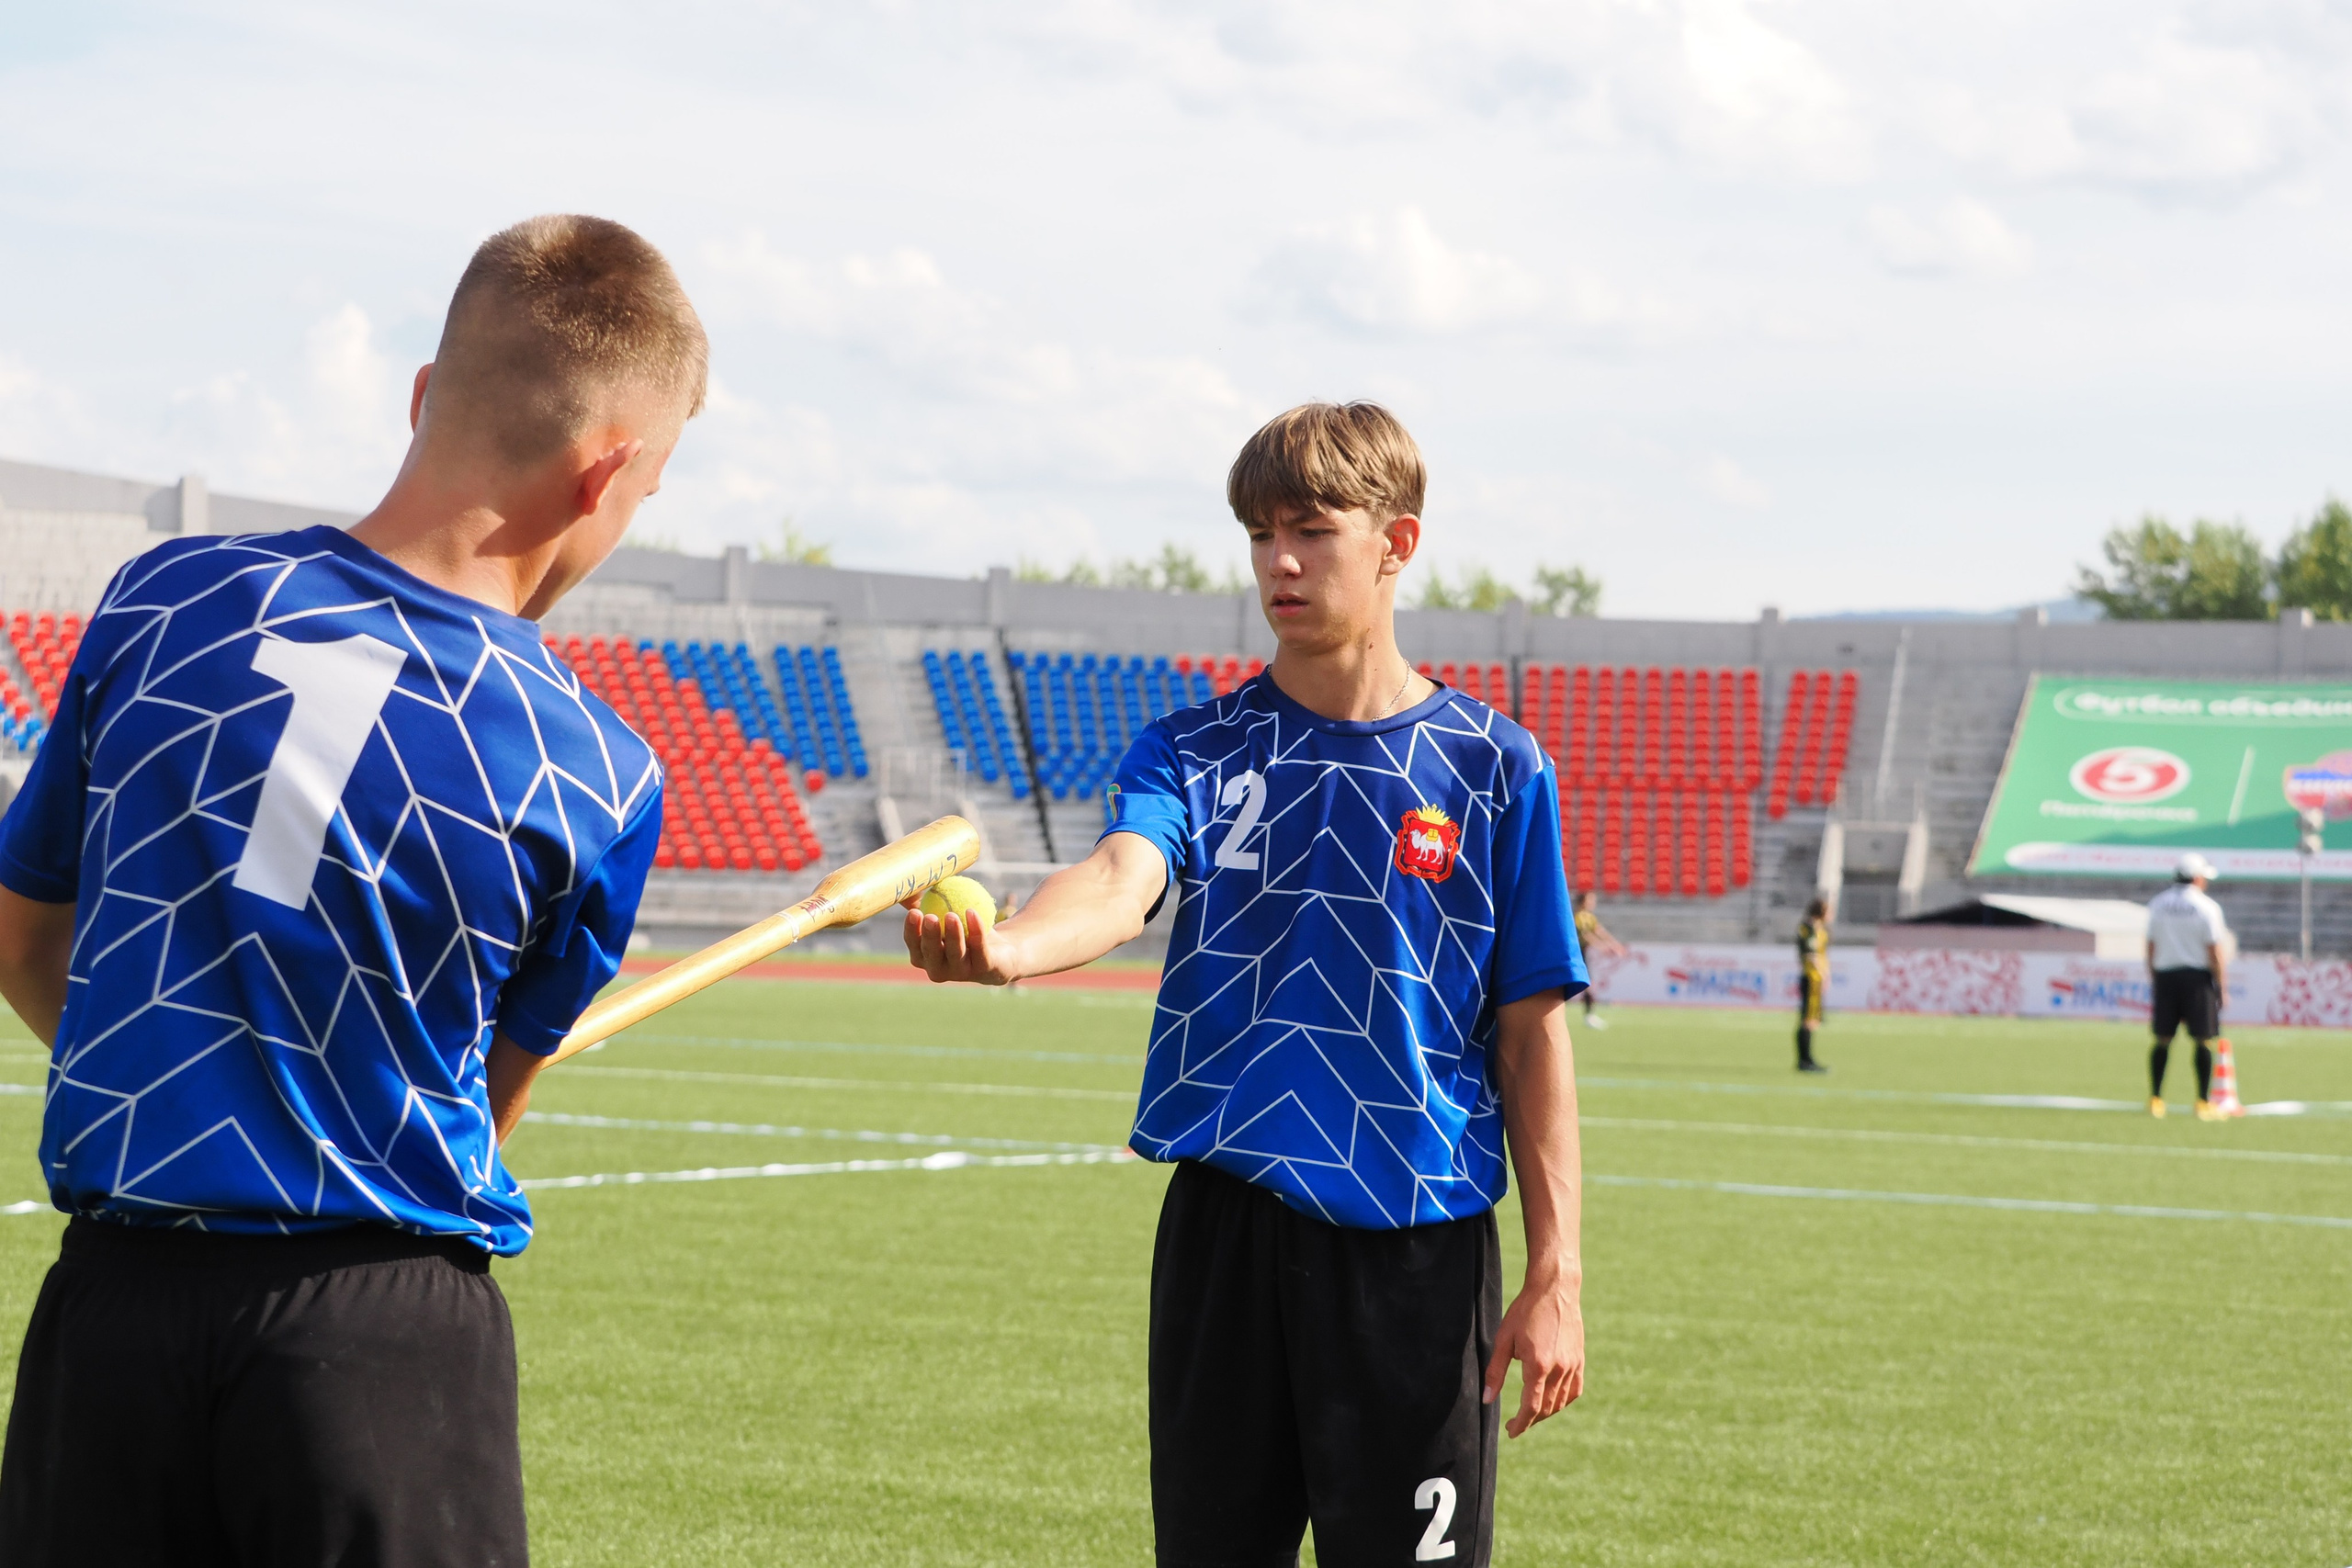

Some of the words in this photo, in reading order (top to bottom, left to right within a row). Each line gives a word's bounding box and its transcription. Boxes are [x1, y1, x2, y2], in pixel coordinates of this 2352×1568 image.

[232, 634, 409, 911] 1
[1215, 770, 1267, 871] 2
[1414, 1477, 1457, 1562] 2
